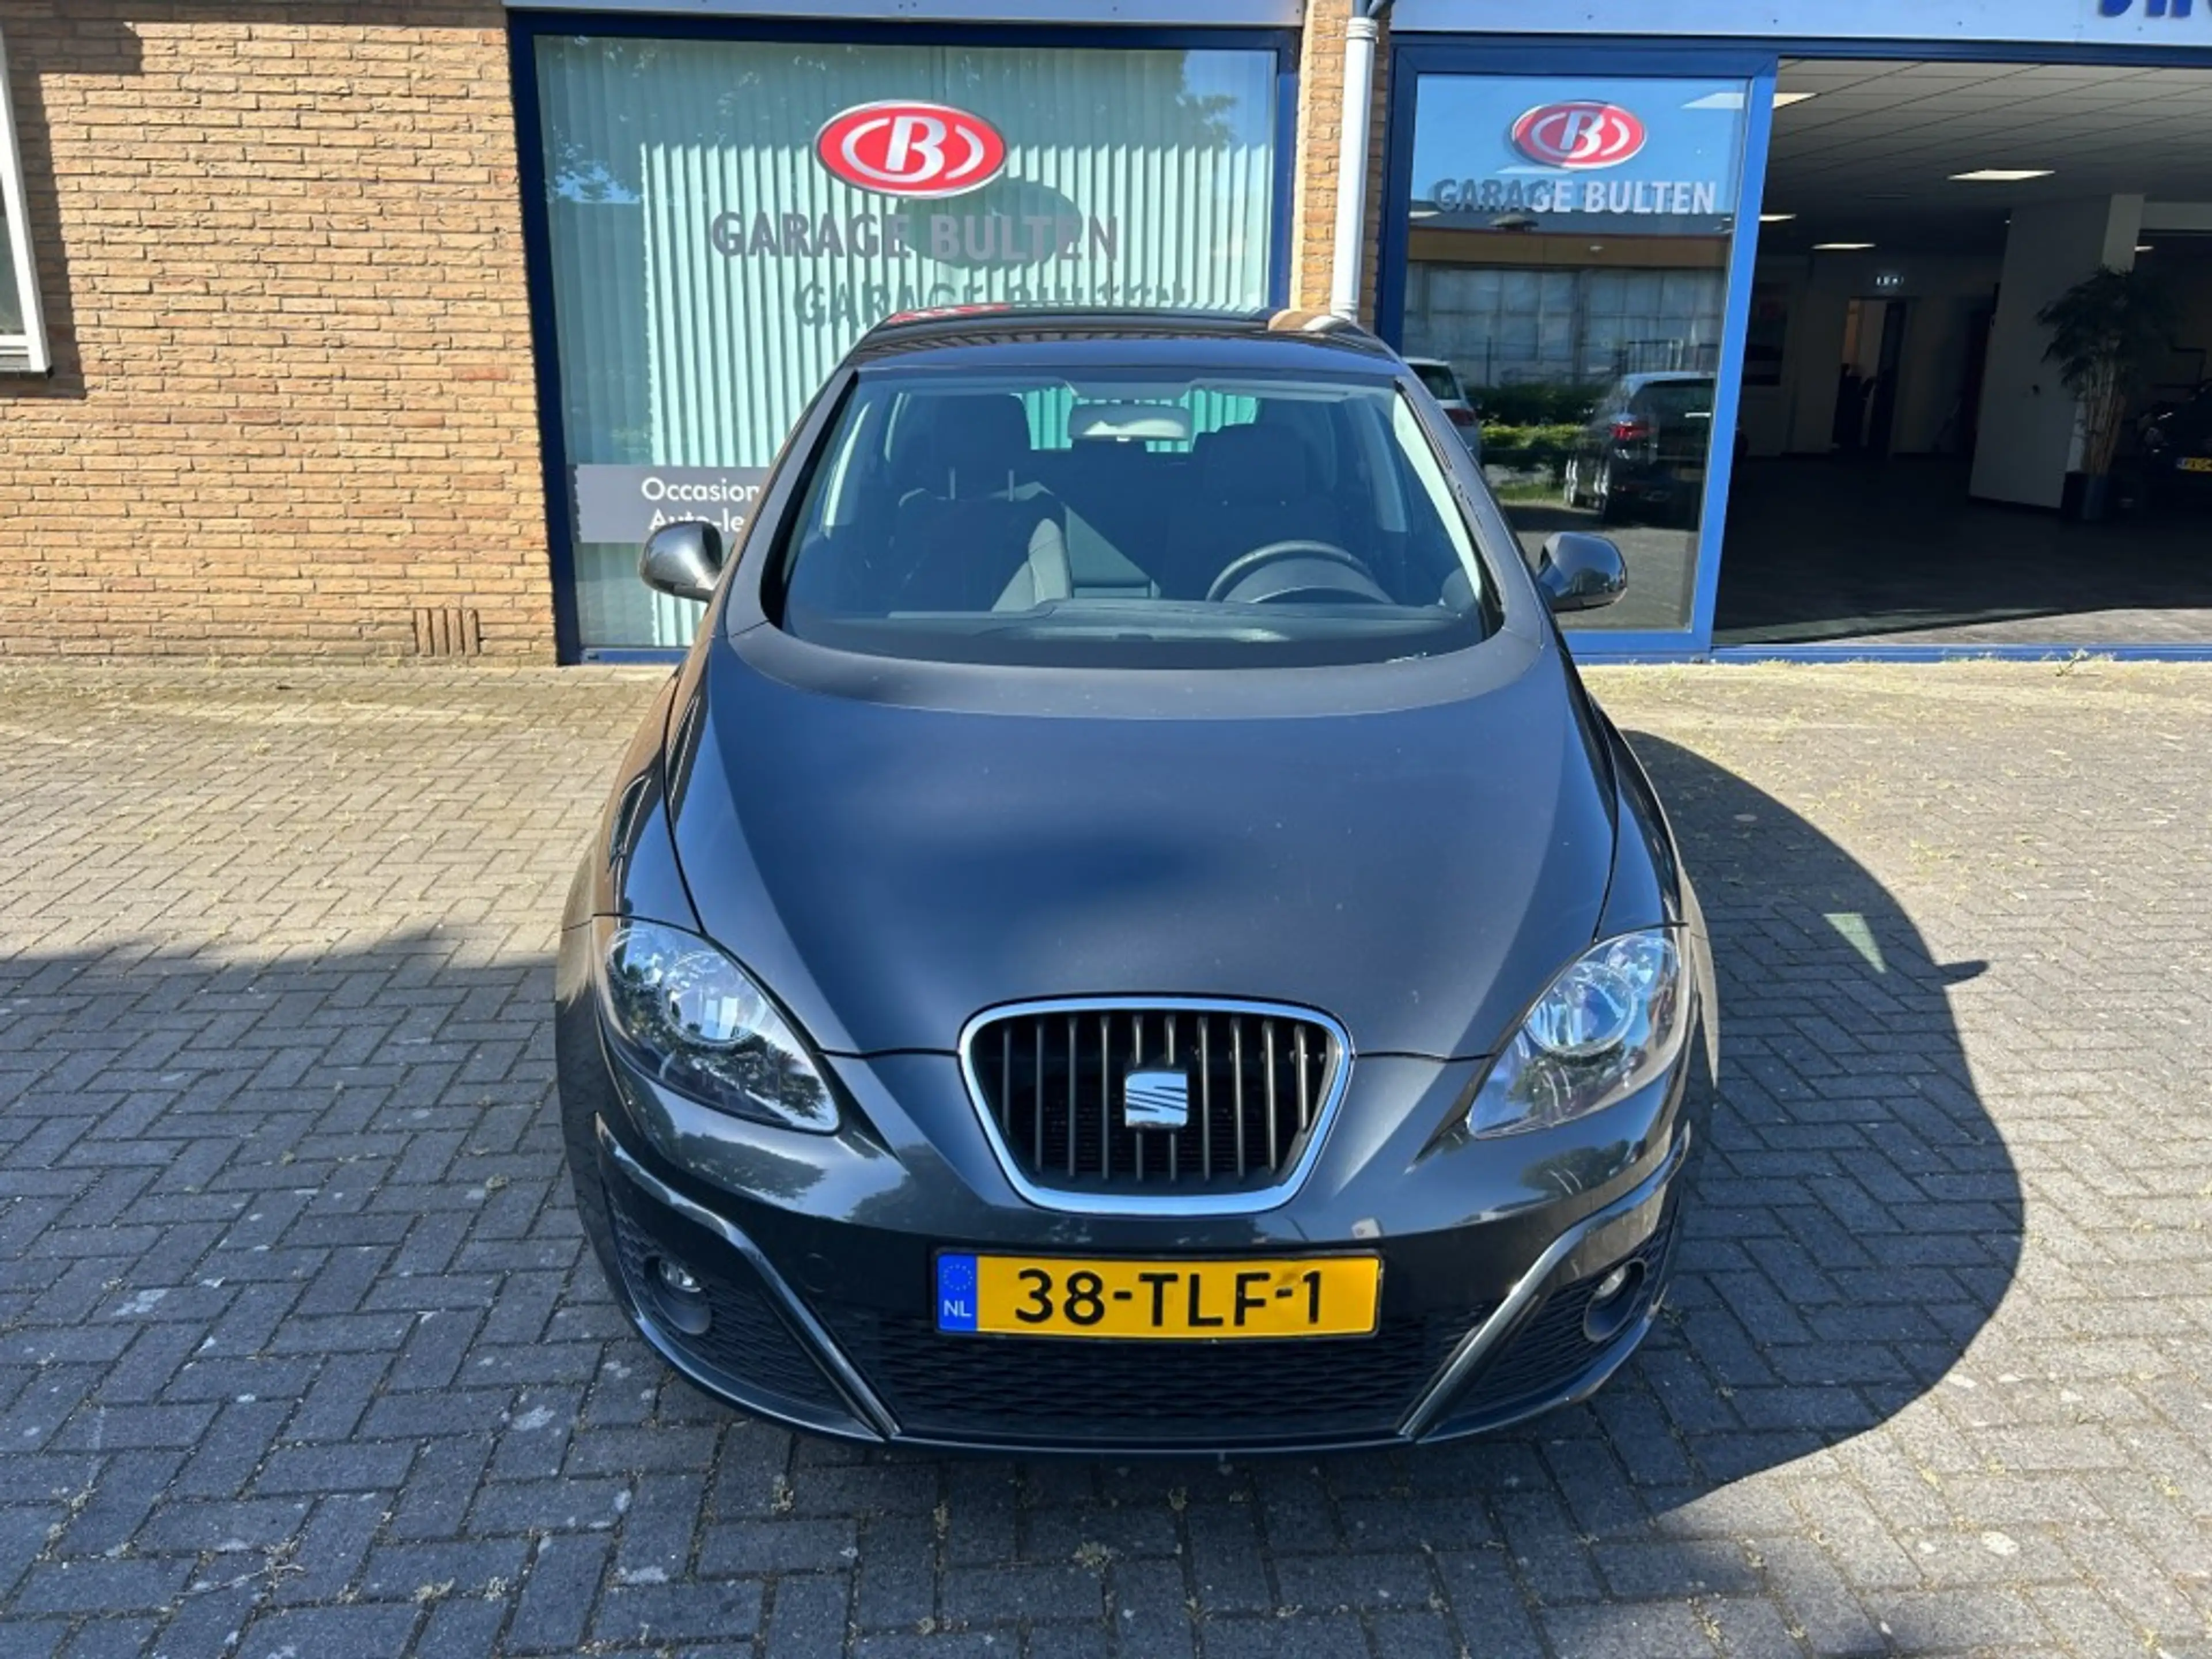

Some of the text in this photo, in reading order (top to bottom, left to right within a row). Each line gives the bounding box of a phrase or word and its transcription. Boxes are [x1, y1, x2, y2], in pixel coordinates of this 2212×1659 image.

[1433, 179, 1716, 215] GARAGE BULTEN
[712, 211, 1117, 261] GARAGE BULTEN
[944, 1269, 1321, 1326] NL 38-TLF-1
